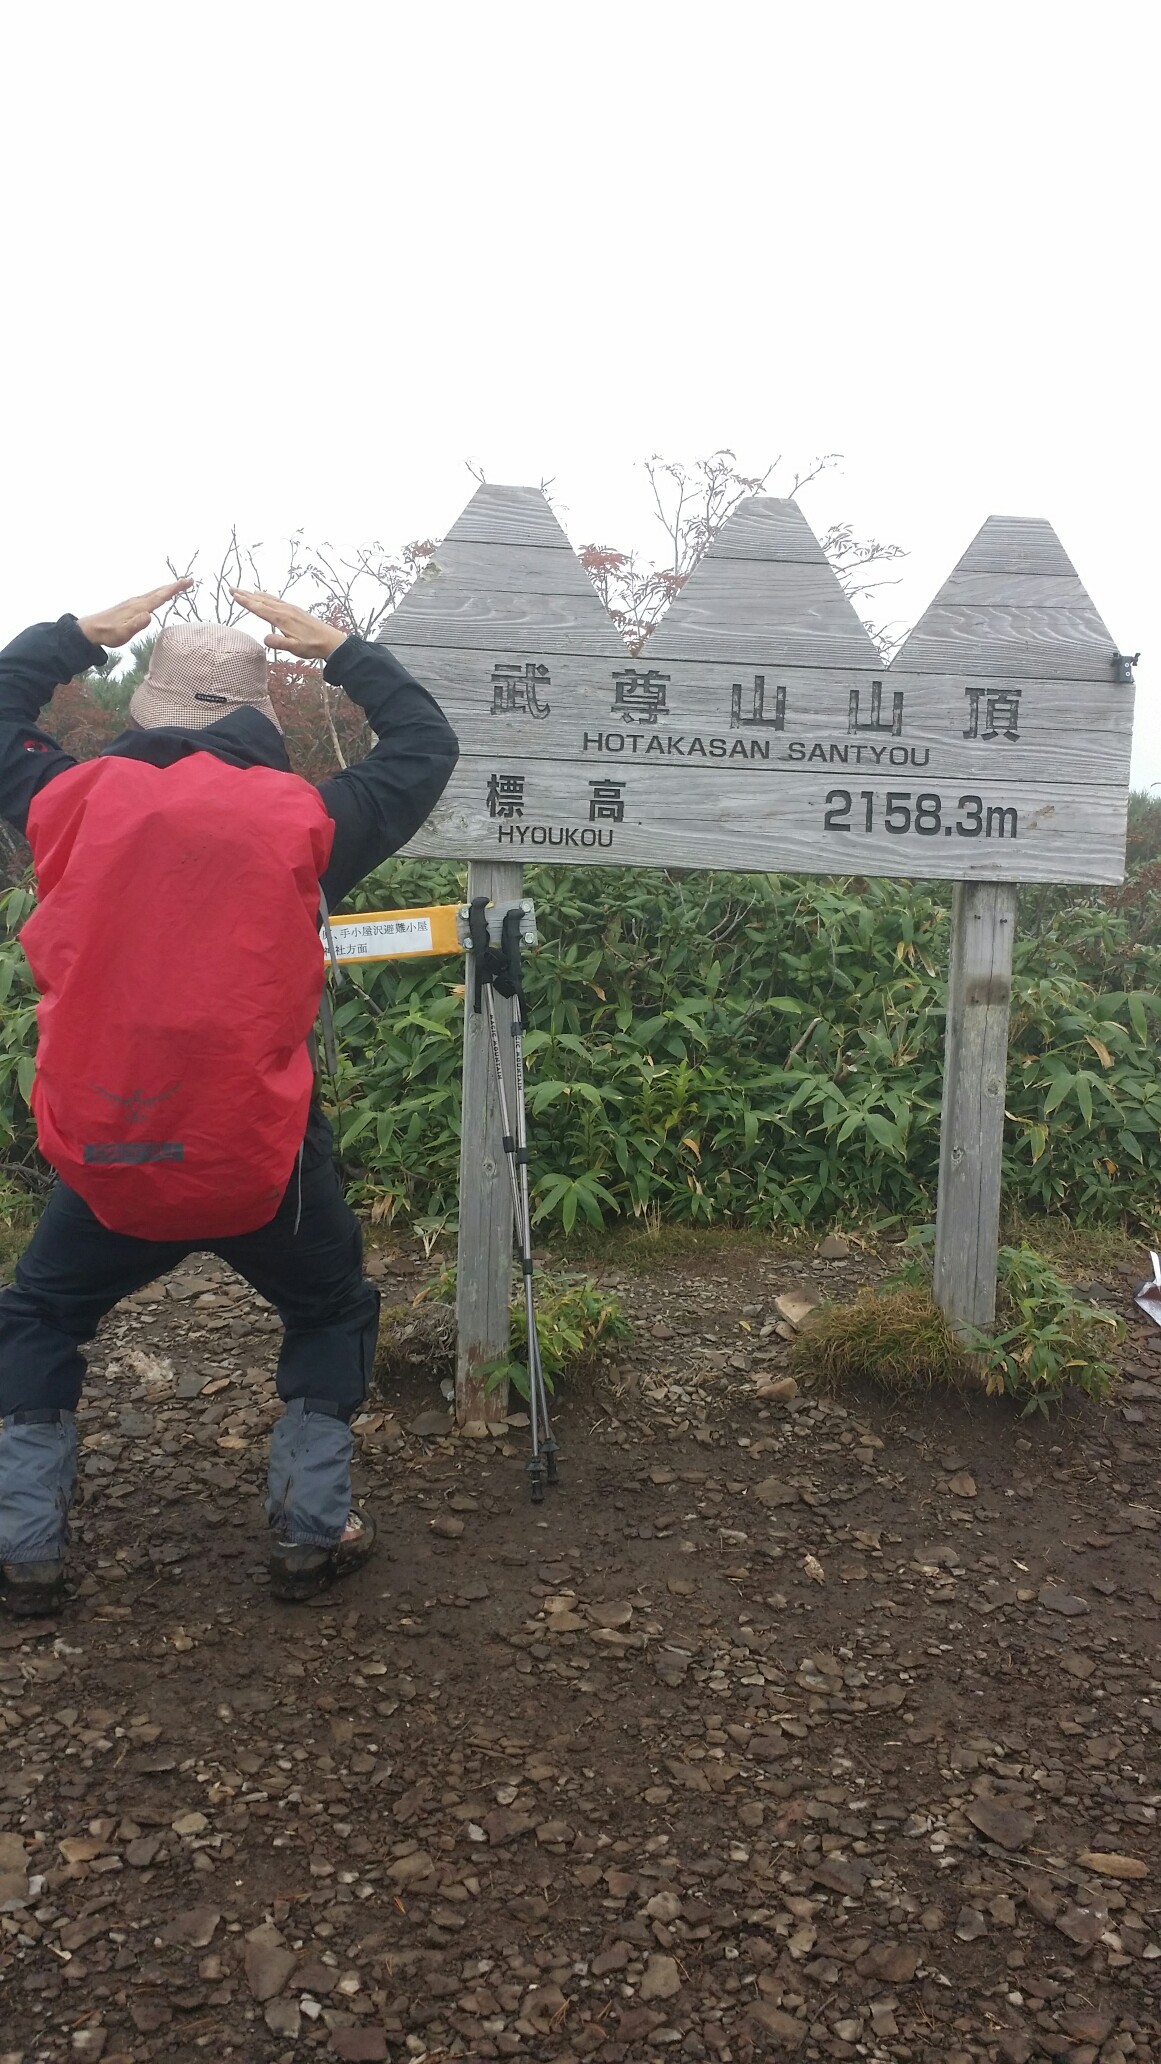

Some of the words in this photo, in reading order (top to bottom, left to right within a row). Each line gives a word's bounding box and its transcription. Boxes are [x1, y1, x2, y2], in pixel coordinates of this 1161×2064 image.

[490, 663, 1022, 742] 武尊山山頂
[583, 732, 770, 760] HOTAKASAN
[788, 741, 930, 767] SANTYOU
[486, 773, 627, 823] 標高
[823, 789, 1018, 838] 2158.3m
[498, 825, 614, 848] HYOUKOU
[493, 1040, 503, 1080] MOUNTAIN
